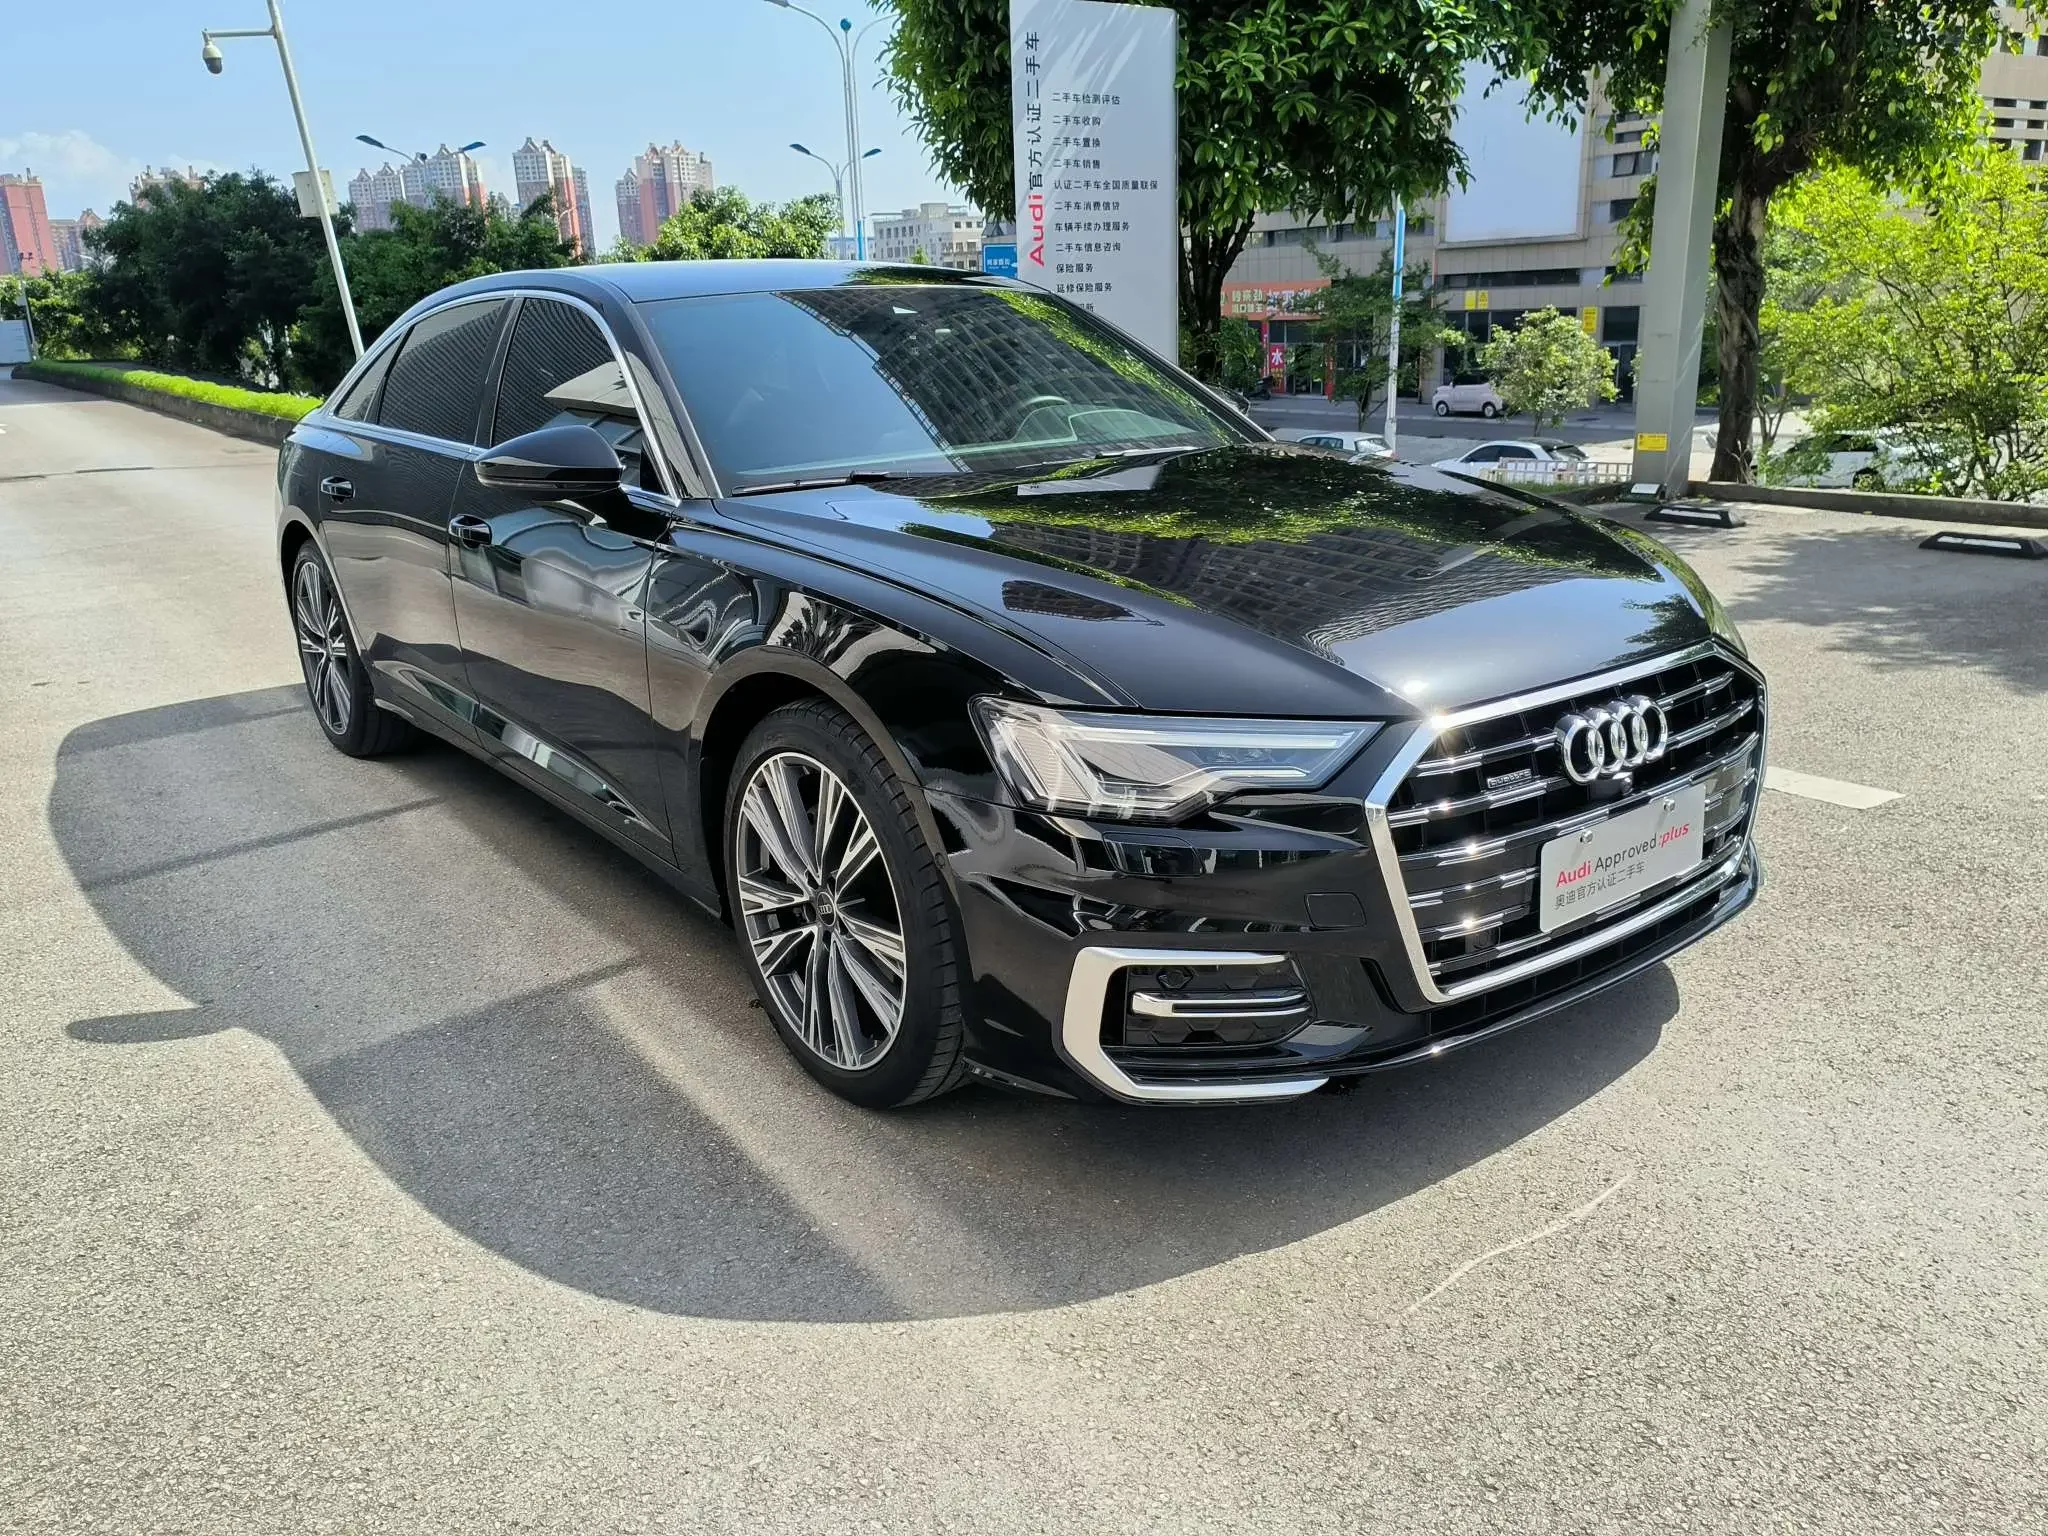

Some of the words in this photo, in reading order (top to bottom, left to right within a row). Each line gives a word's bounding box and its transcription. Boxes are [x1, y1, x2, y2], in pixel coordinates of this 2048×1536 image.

[1052, 92, 1120, 105] 二手车检测评估
[1025, 31, 1043, 190] 官方认证二手车
[1052, 115, 1101, 126] 二手车收购
[1052, 137, 1101, 148] 二手车置换
[1052, 159, 1101, 170] 二手车销售
[1054, 180, 1158, 190] 认证二手车全国质量联保
[1054, 201, 1120, 211] 二手车消费信贷
[1029, 193, 1044, 267] Audi
[1055, 222, 1130, 232] 车辆手续办理服务
[1056, 242, 1121, 252] 二手车信息咨询
[1056, 263, 1094, 273] 保险服务
[1556, 860, 1591, 888] Audi
[1554, 861, 1646, 910] 奥迪官方认证二手车
